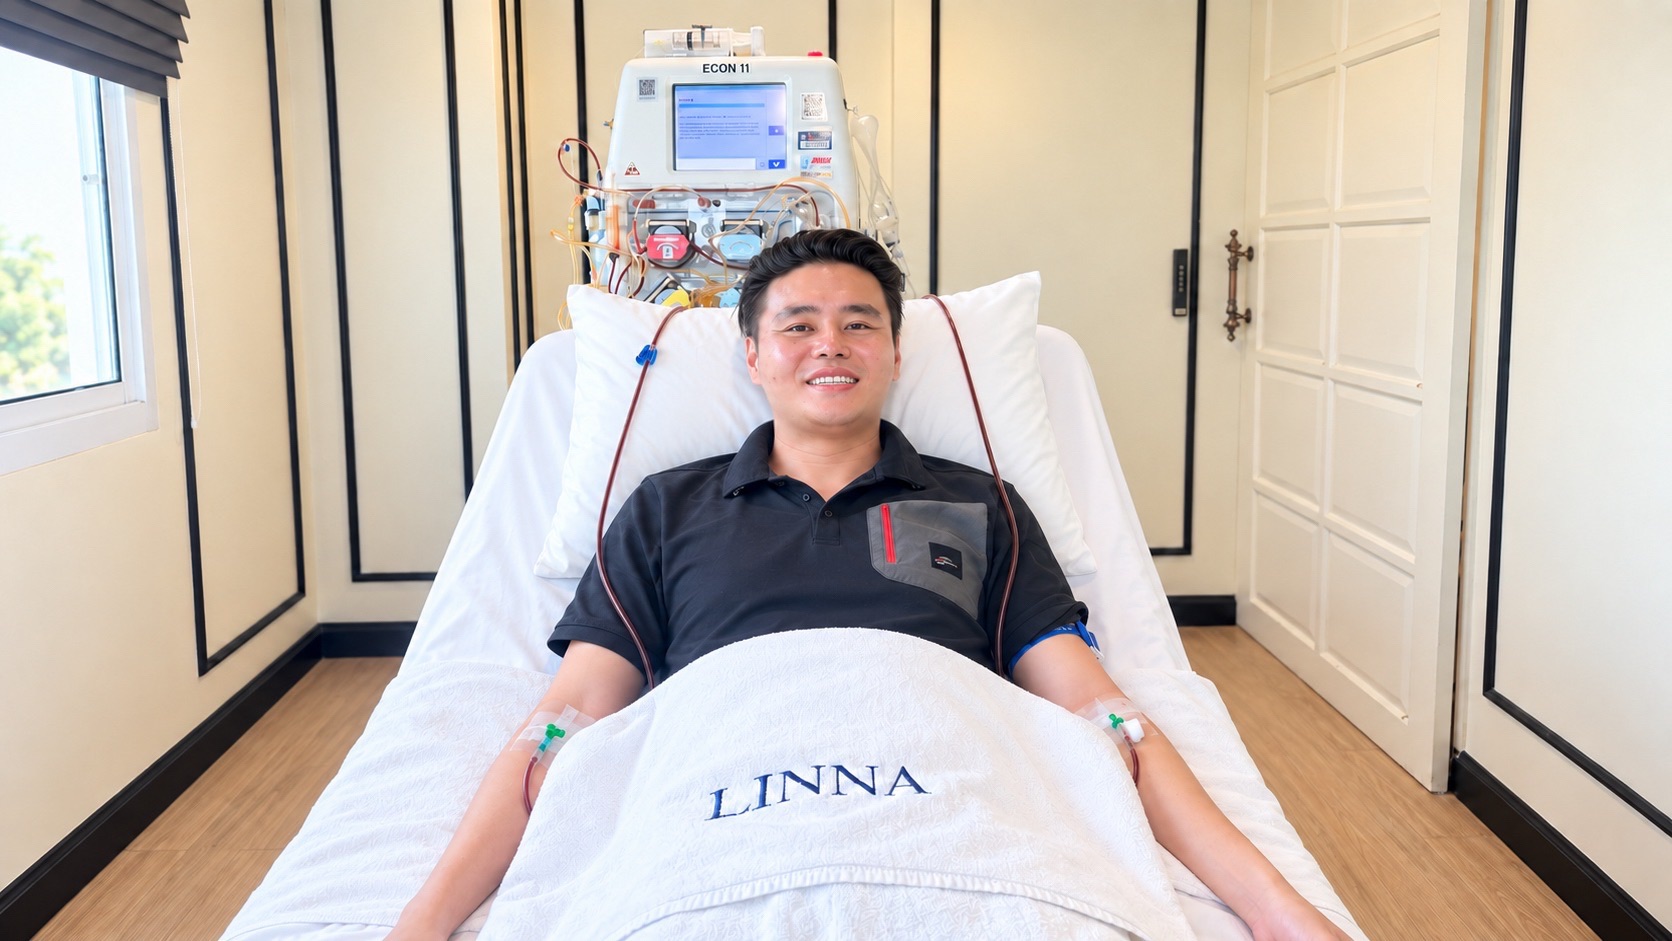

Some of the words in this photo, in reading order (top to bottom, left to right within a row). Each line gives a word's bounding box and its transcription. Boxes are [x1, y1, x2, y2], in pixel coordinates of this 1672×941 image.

[702, 63, 736, 74] ECON
[740, 63, 750, 73] 11
[704, 764, 932, 821] LINNA
